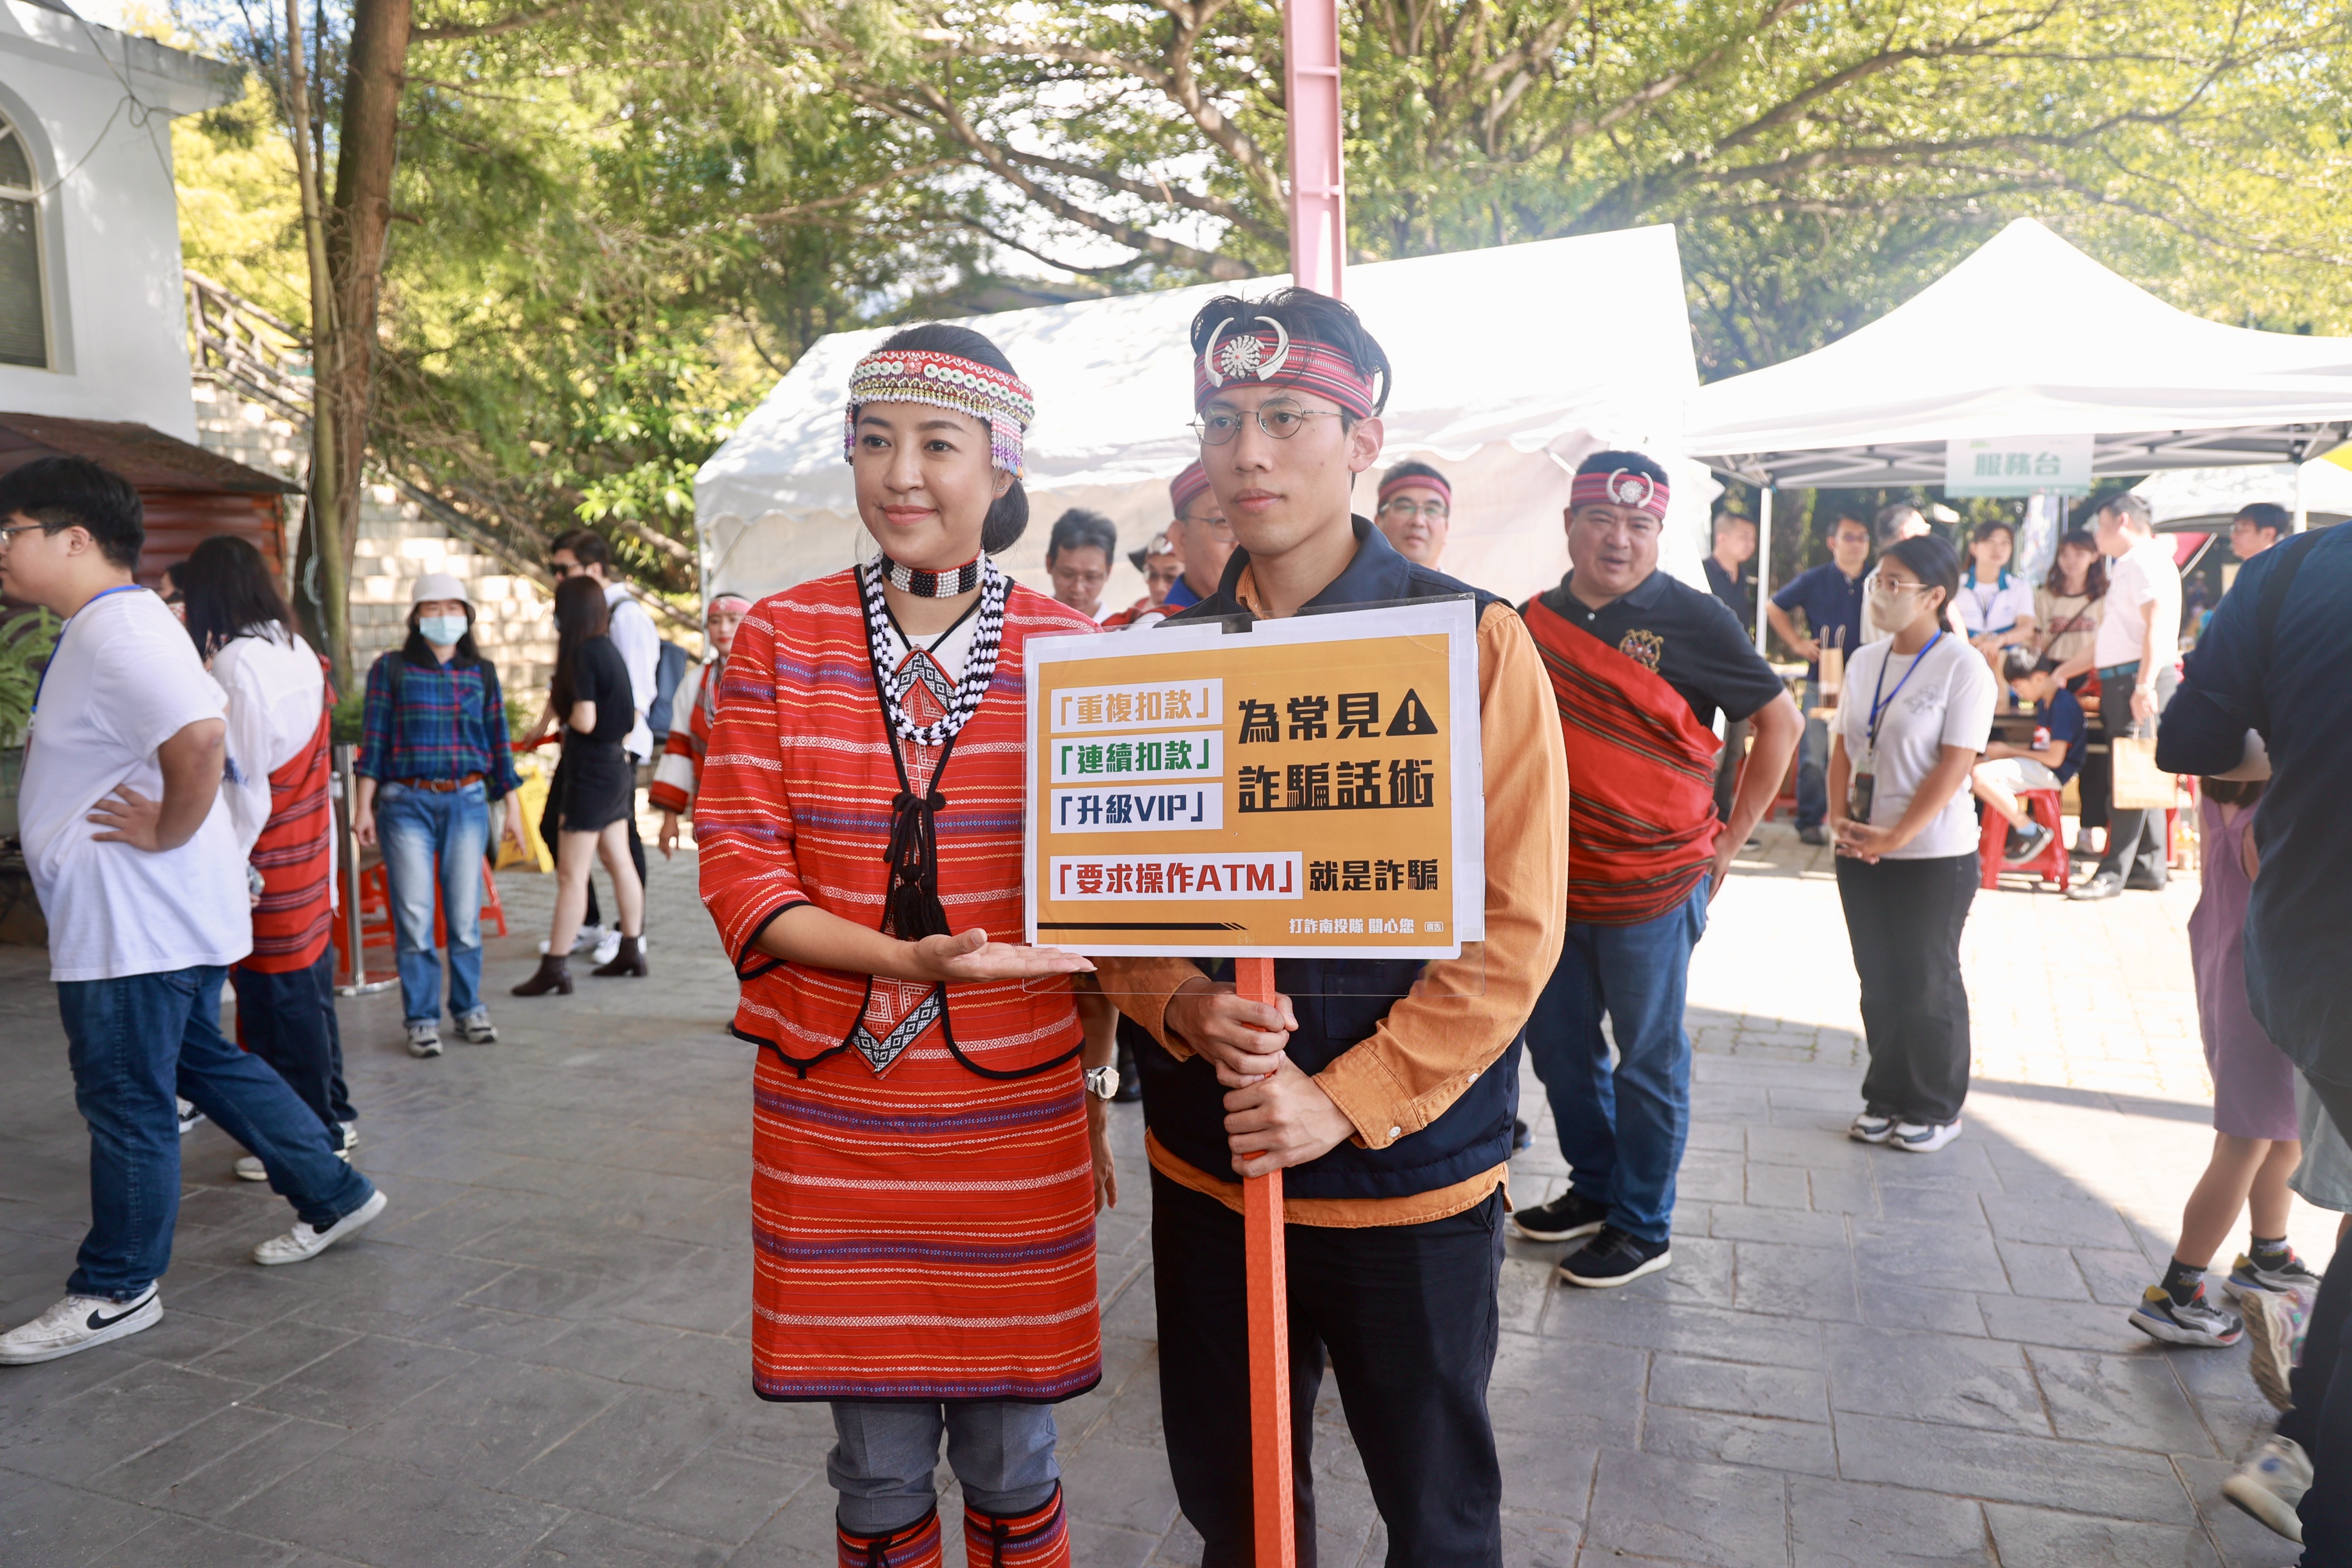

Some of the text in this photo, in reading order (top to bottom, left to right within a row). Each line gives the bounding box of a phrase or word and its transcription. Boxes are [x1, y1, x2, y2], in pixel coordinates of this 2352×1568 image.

[1975, 451, 2061, 476] 服務台
[1061, 687, 1210, 725] 「重複扣款」
[1239, 692, 1381, 744] 為常見
[1061, 738, 1210, 776] 「連續扣款」
[1238, 759, 1434, 813] 詐騙話術
[1061, 791, 1203, 826] 「升級VIP」
[1060, 860, 1292, 894] 「要求操作ATM」
[1309, 858, 1438, 891] 就是詐騙
[1289, 918, 1415, 934] 打詐南投隊 關心您
